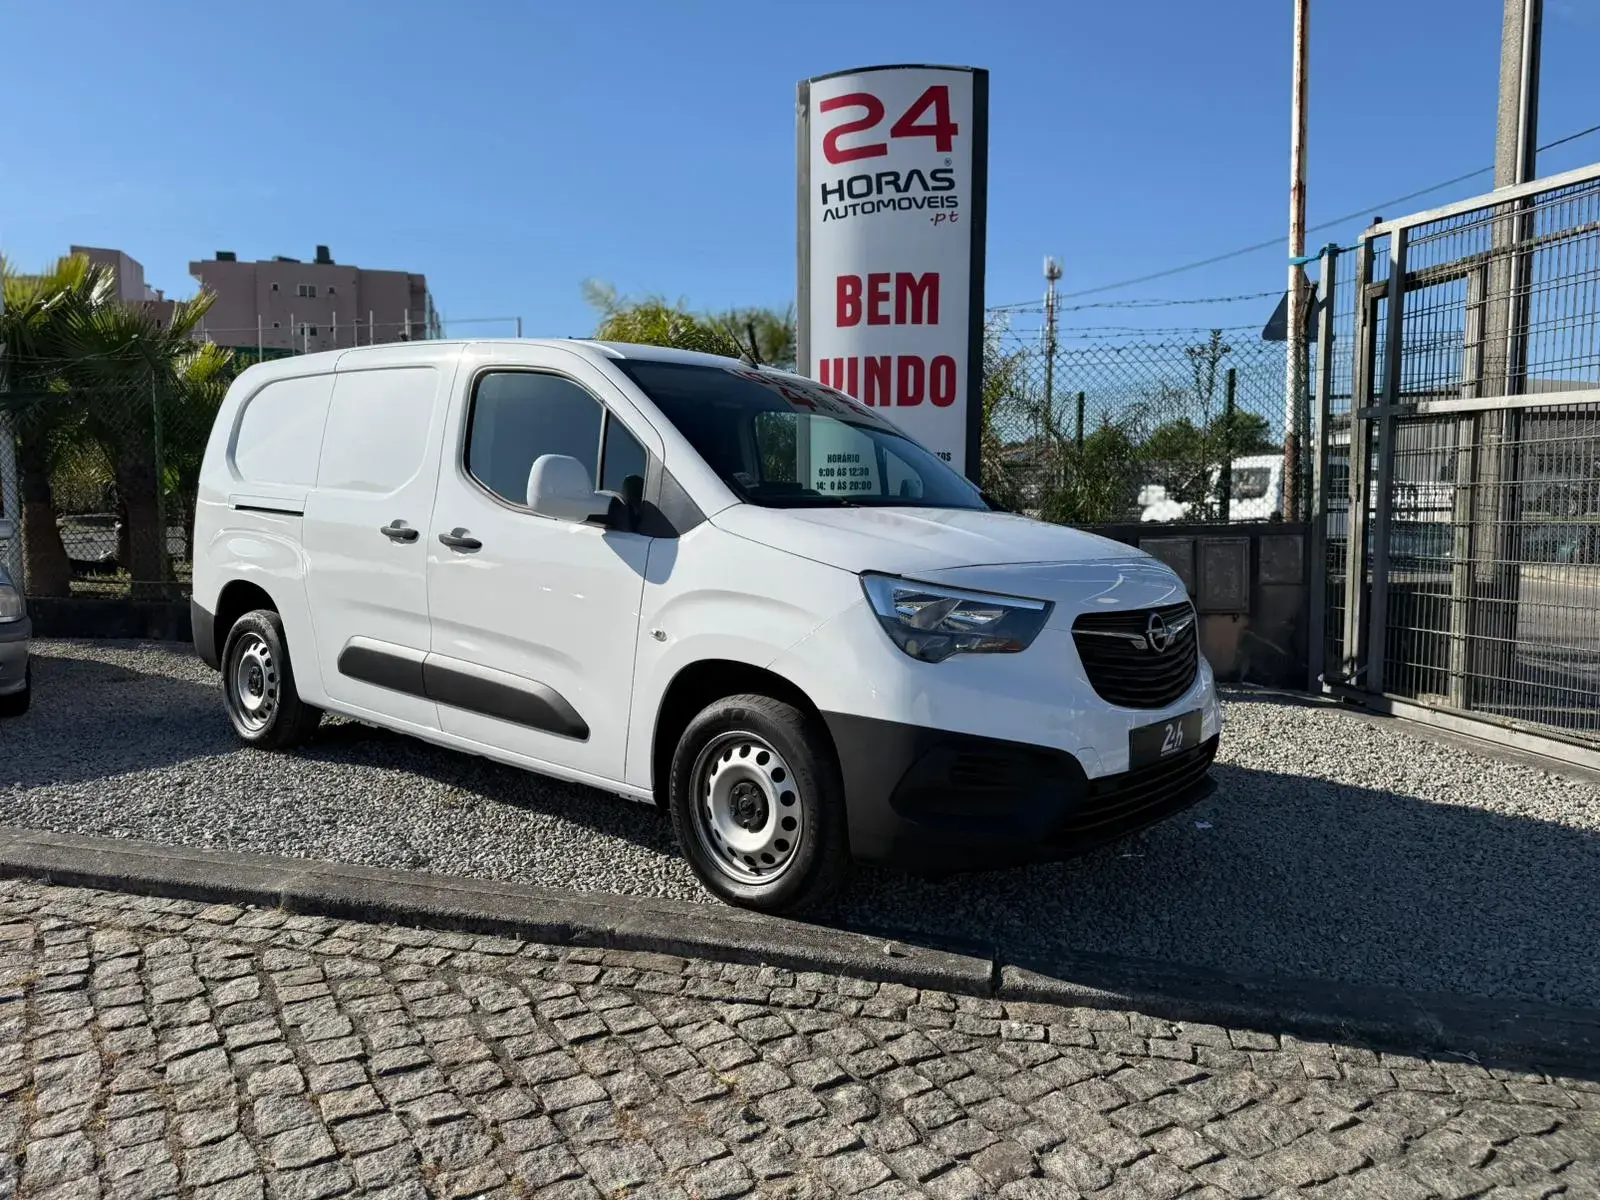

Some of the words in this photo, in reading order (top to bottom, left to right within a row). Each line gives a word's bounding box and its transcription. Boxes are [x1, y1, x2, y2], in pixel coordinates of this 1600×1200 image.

[820, 85, 958, 164] 24
[821, 168, 955, 205] HORAS
[823, 195, 958, 222] AUTOMOVEIS
[837, 272, 940, 328] BEM
